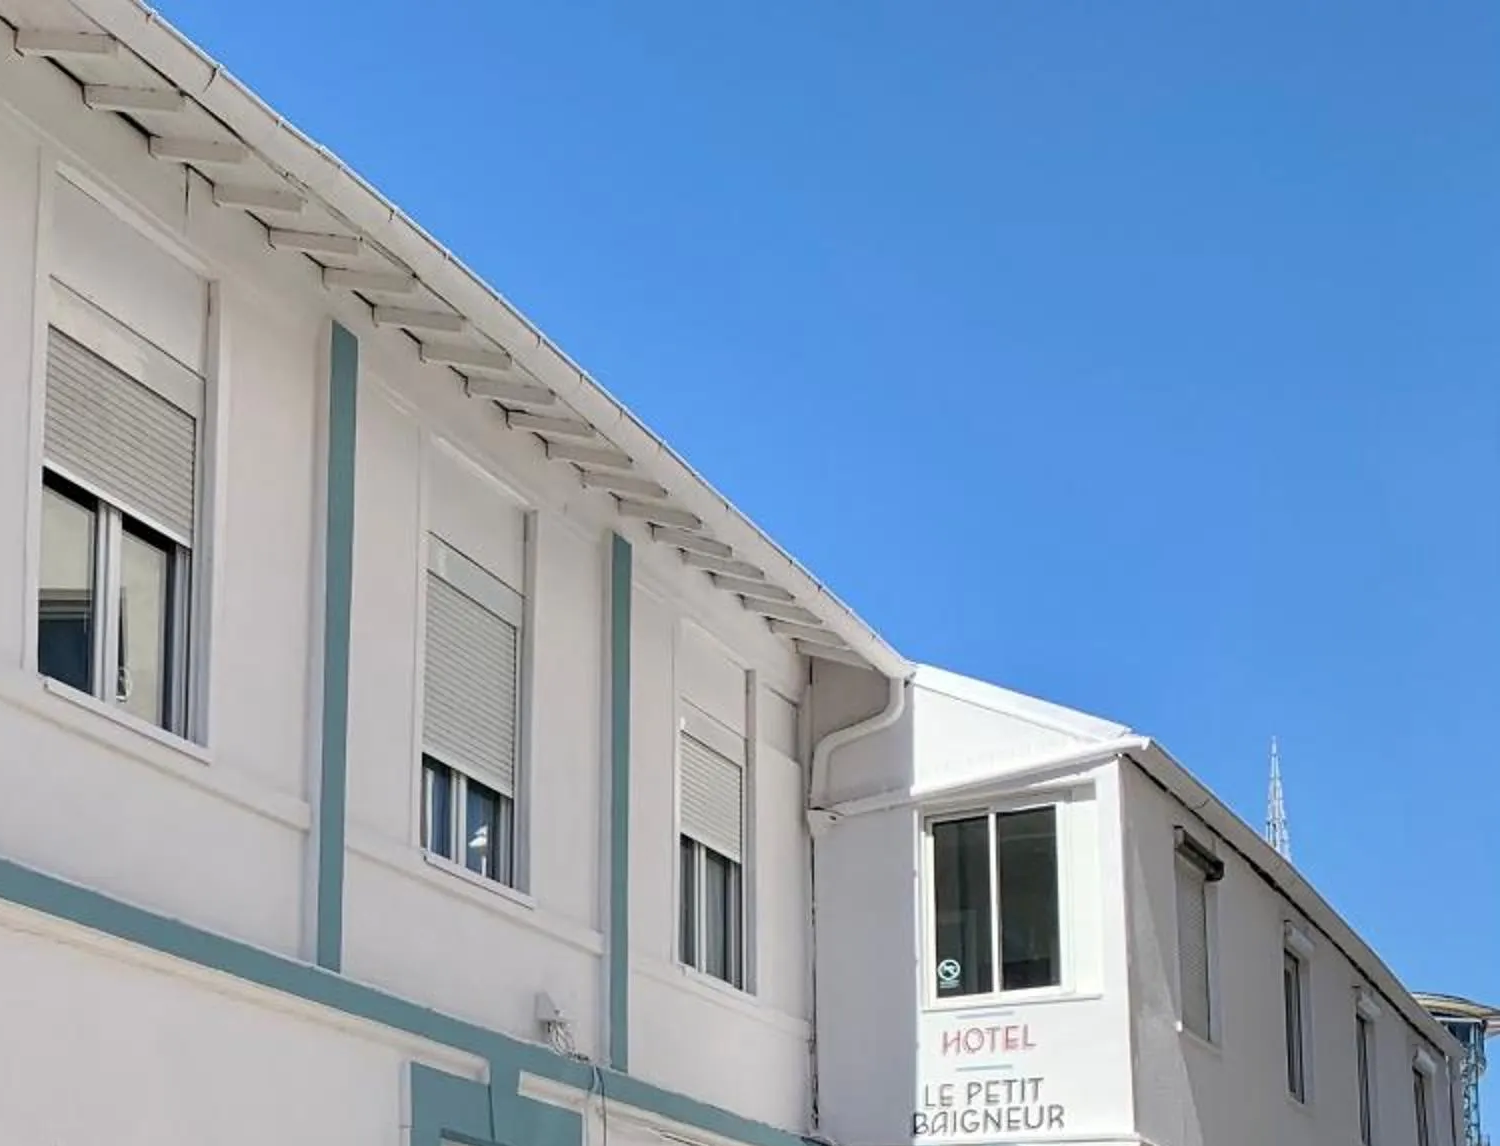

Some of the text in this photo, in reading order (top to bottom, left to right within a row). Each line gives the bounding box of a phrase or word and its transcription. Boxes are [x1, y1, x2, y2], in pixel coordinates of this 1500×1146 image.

[941, 1024, 1037, 1056] HOTEL
[924, 1077, 1045, 1109] LE PETIT
[911, 1104, 1066, 1137] BAIGNEUR
